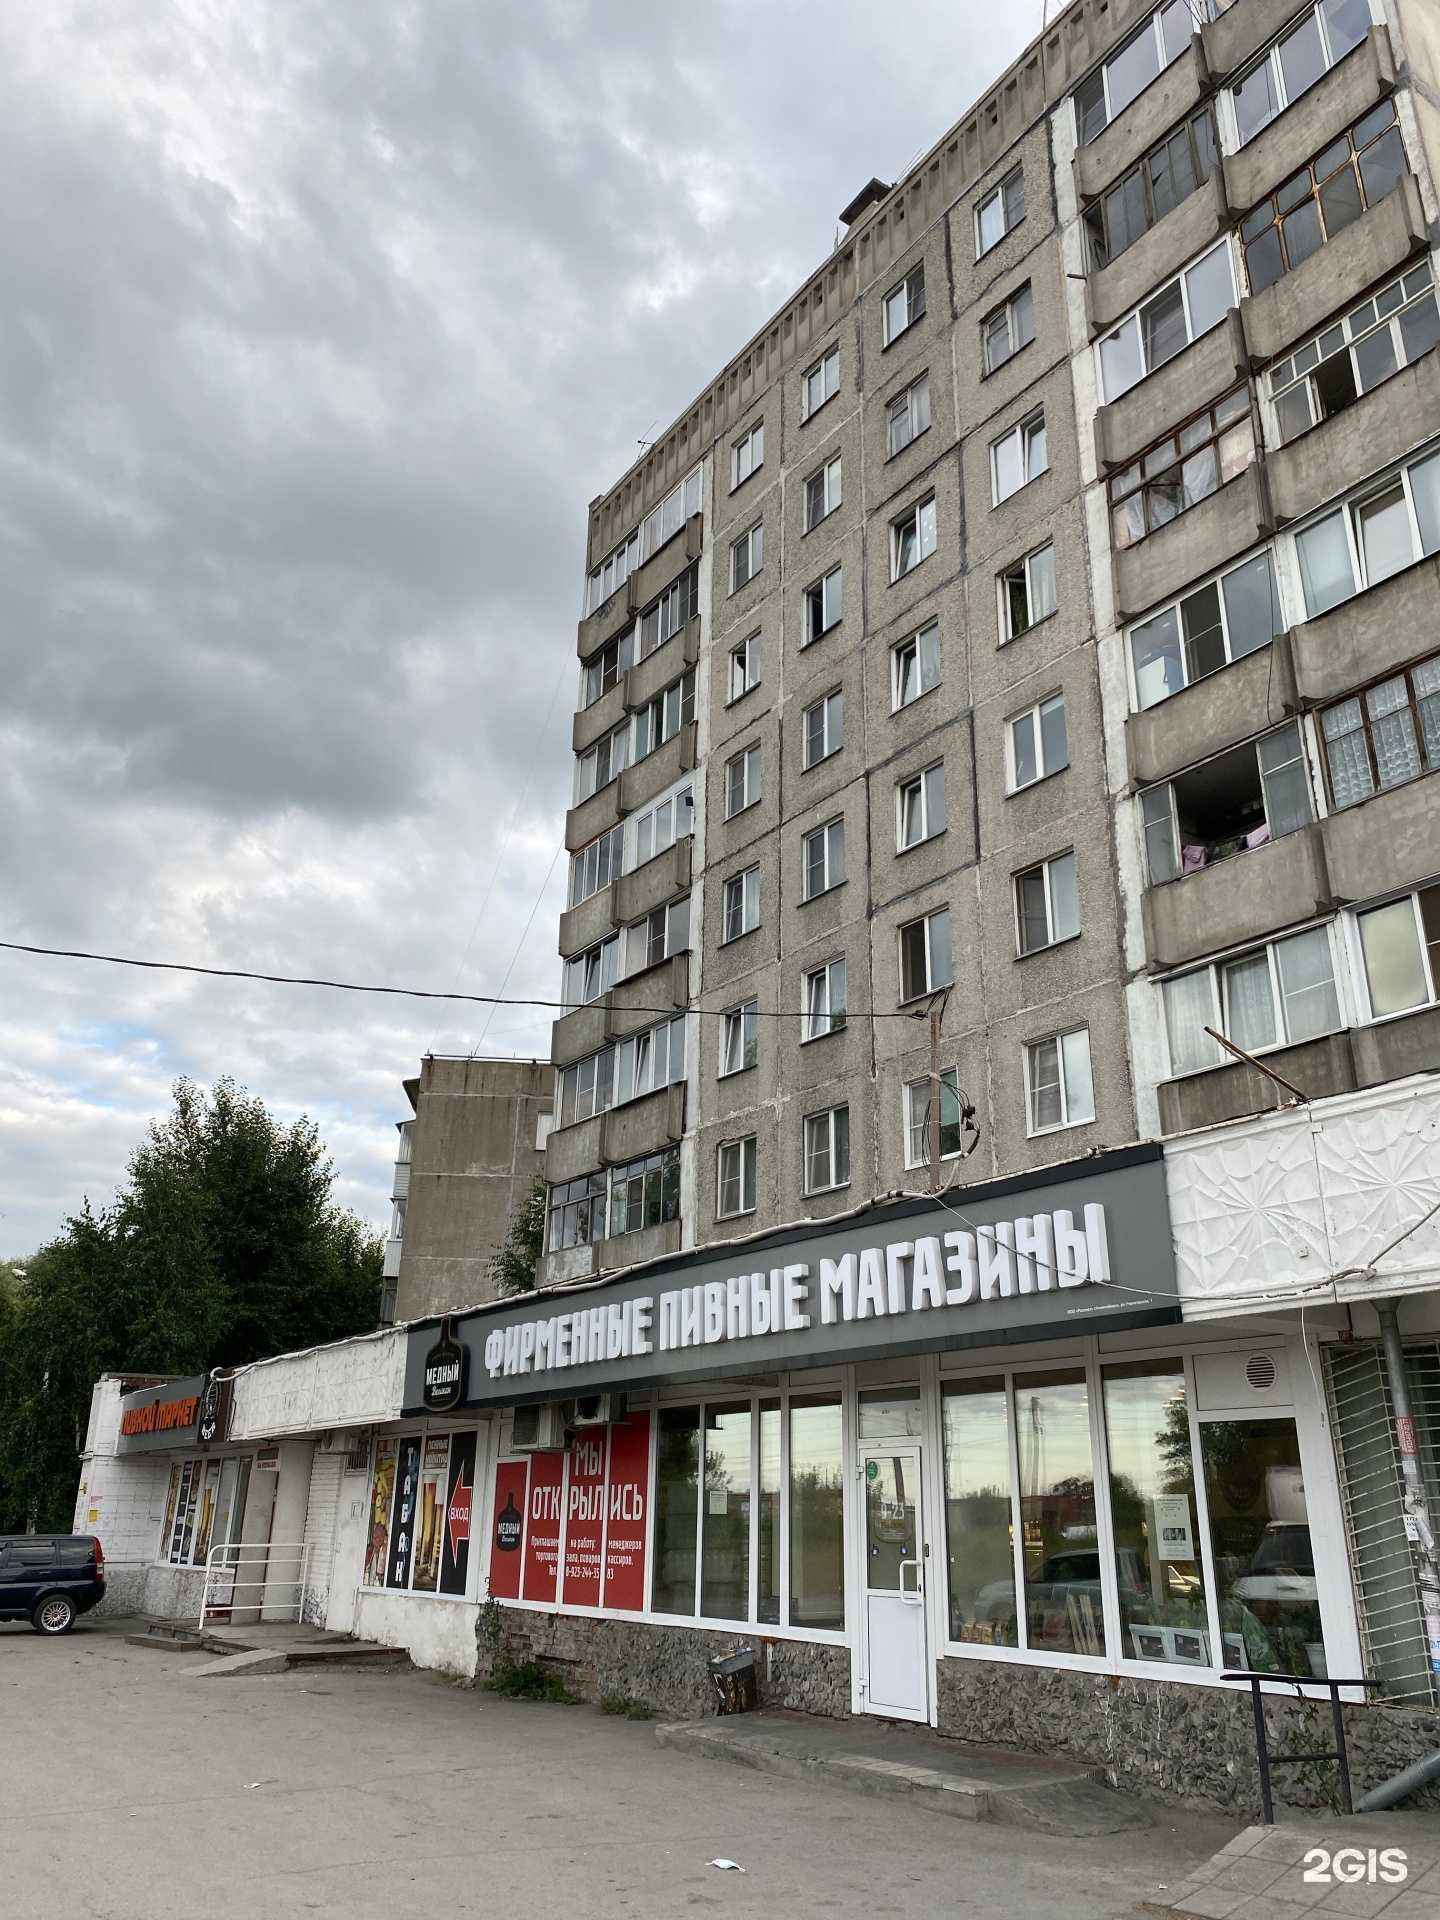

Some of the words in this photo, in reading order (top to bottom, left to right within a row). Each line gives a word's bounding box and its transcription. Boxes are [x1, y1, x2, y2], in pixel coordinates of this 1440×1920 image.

[485, 1297, 653, 1378] ФИРМЕННЫЕ
[659, 1263, 811, 1350] ПИВНЫЕ
[819, 1203, 1111, 1325] МАГАЗИНЫ
[426, 1360, 459, 1385] МЕДНЫЙ
[574, 1441, 603, 1476] МЫ
[450, 1507, 469, 1523] ВХОД
[532, 1484, 643, 1521] ОТКРЫЛИСЬ
[498, 1520, 520, 1534] МЕДНЫЙ
